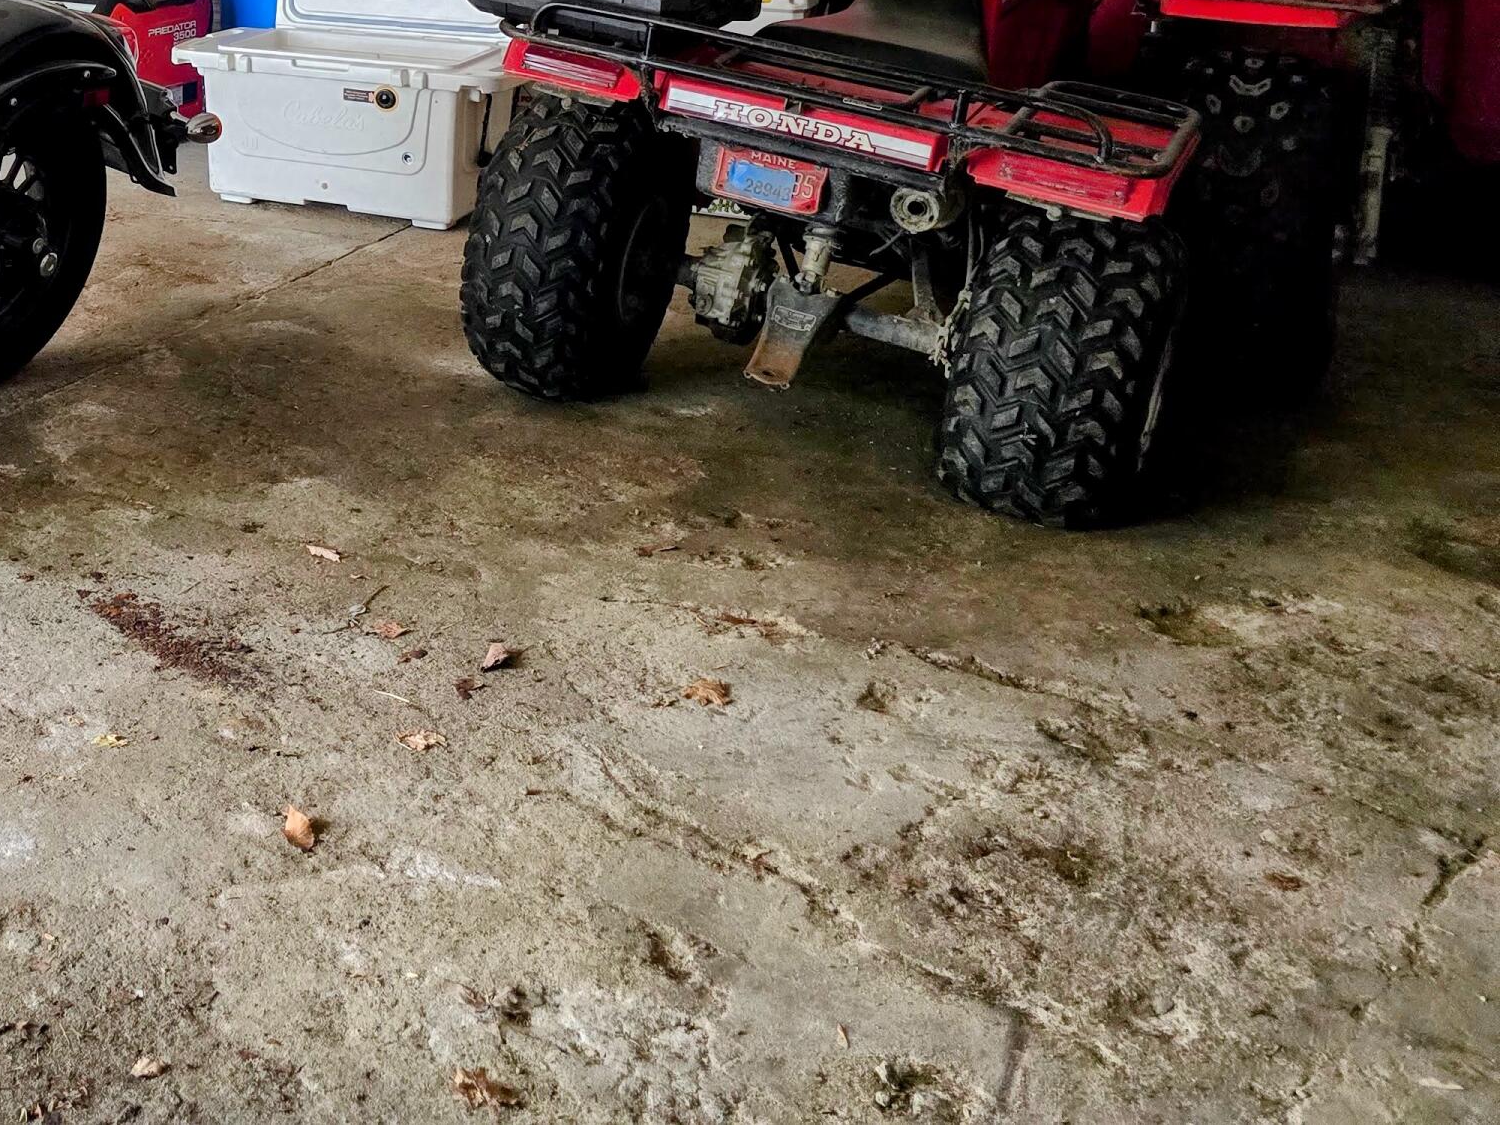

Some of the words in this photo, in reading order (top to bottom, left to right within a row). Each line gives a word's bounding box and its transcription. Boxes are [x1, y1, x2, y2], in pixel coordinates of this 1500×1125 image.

[148, 20, 197, 37] PREDATOR
[173, 28, 197, 41] 3500
[283, 99, 365, 132] Cabela's
[712, 99, 876, 153] HONDA
[751, 150, 797, 169] MAINE
[743, 178, 792, 202] 28943
